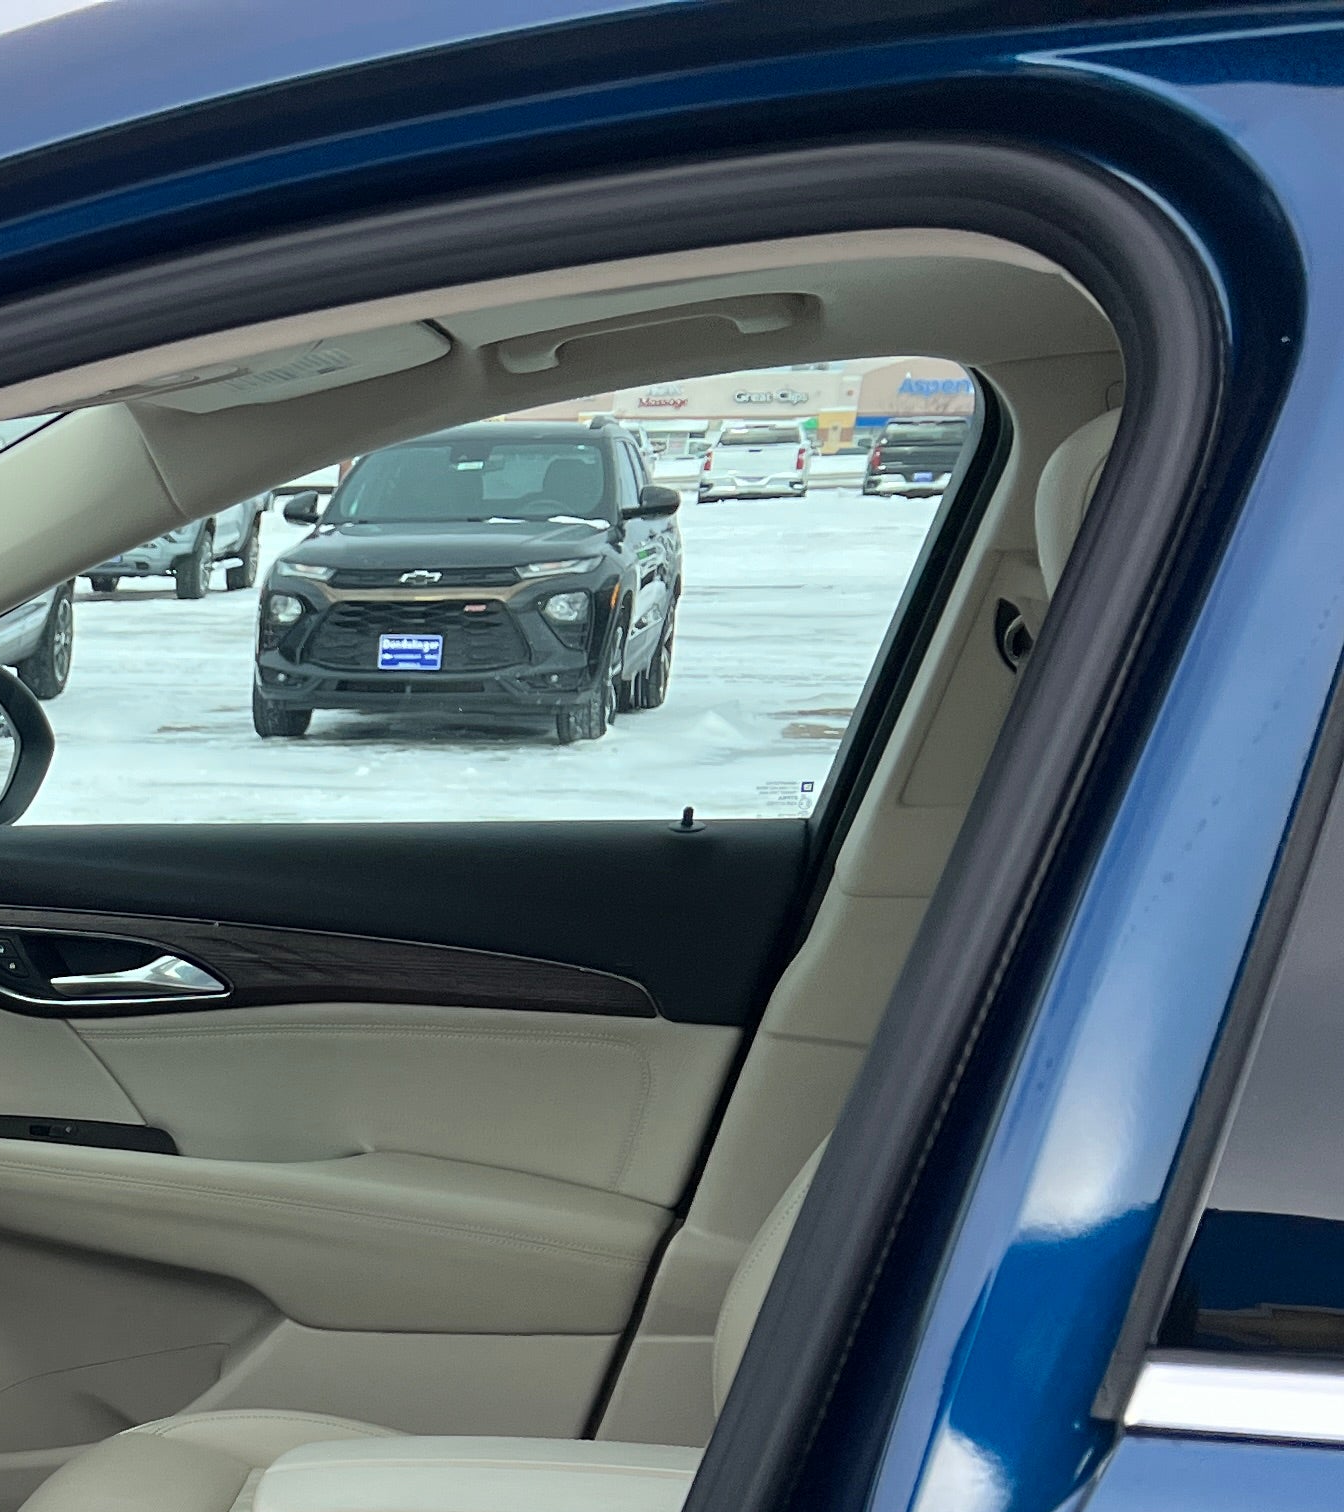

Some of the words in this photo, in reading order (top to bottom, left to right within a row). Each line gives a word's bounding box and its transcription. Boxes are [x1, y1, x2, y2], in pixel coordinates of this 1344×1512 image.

[897, 372, 971, 397] Aspen
[734, 390, 772, 403] Great
[775, 390, 810, 405] Clips
